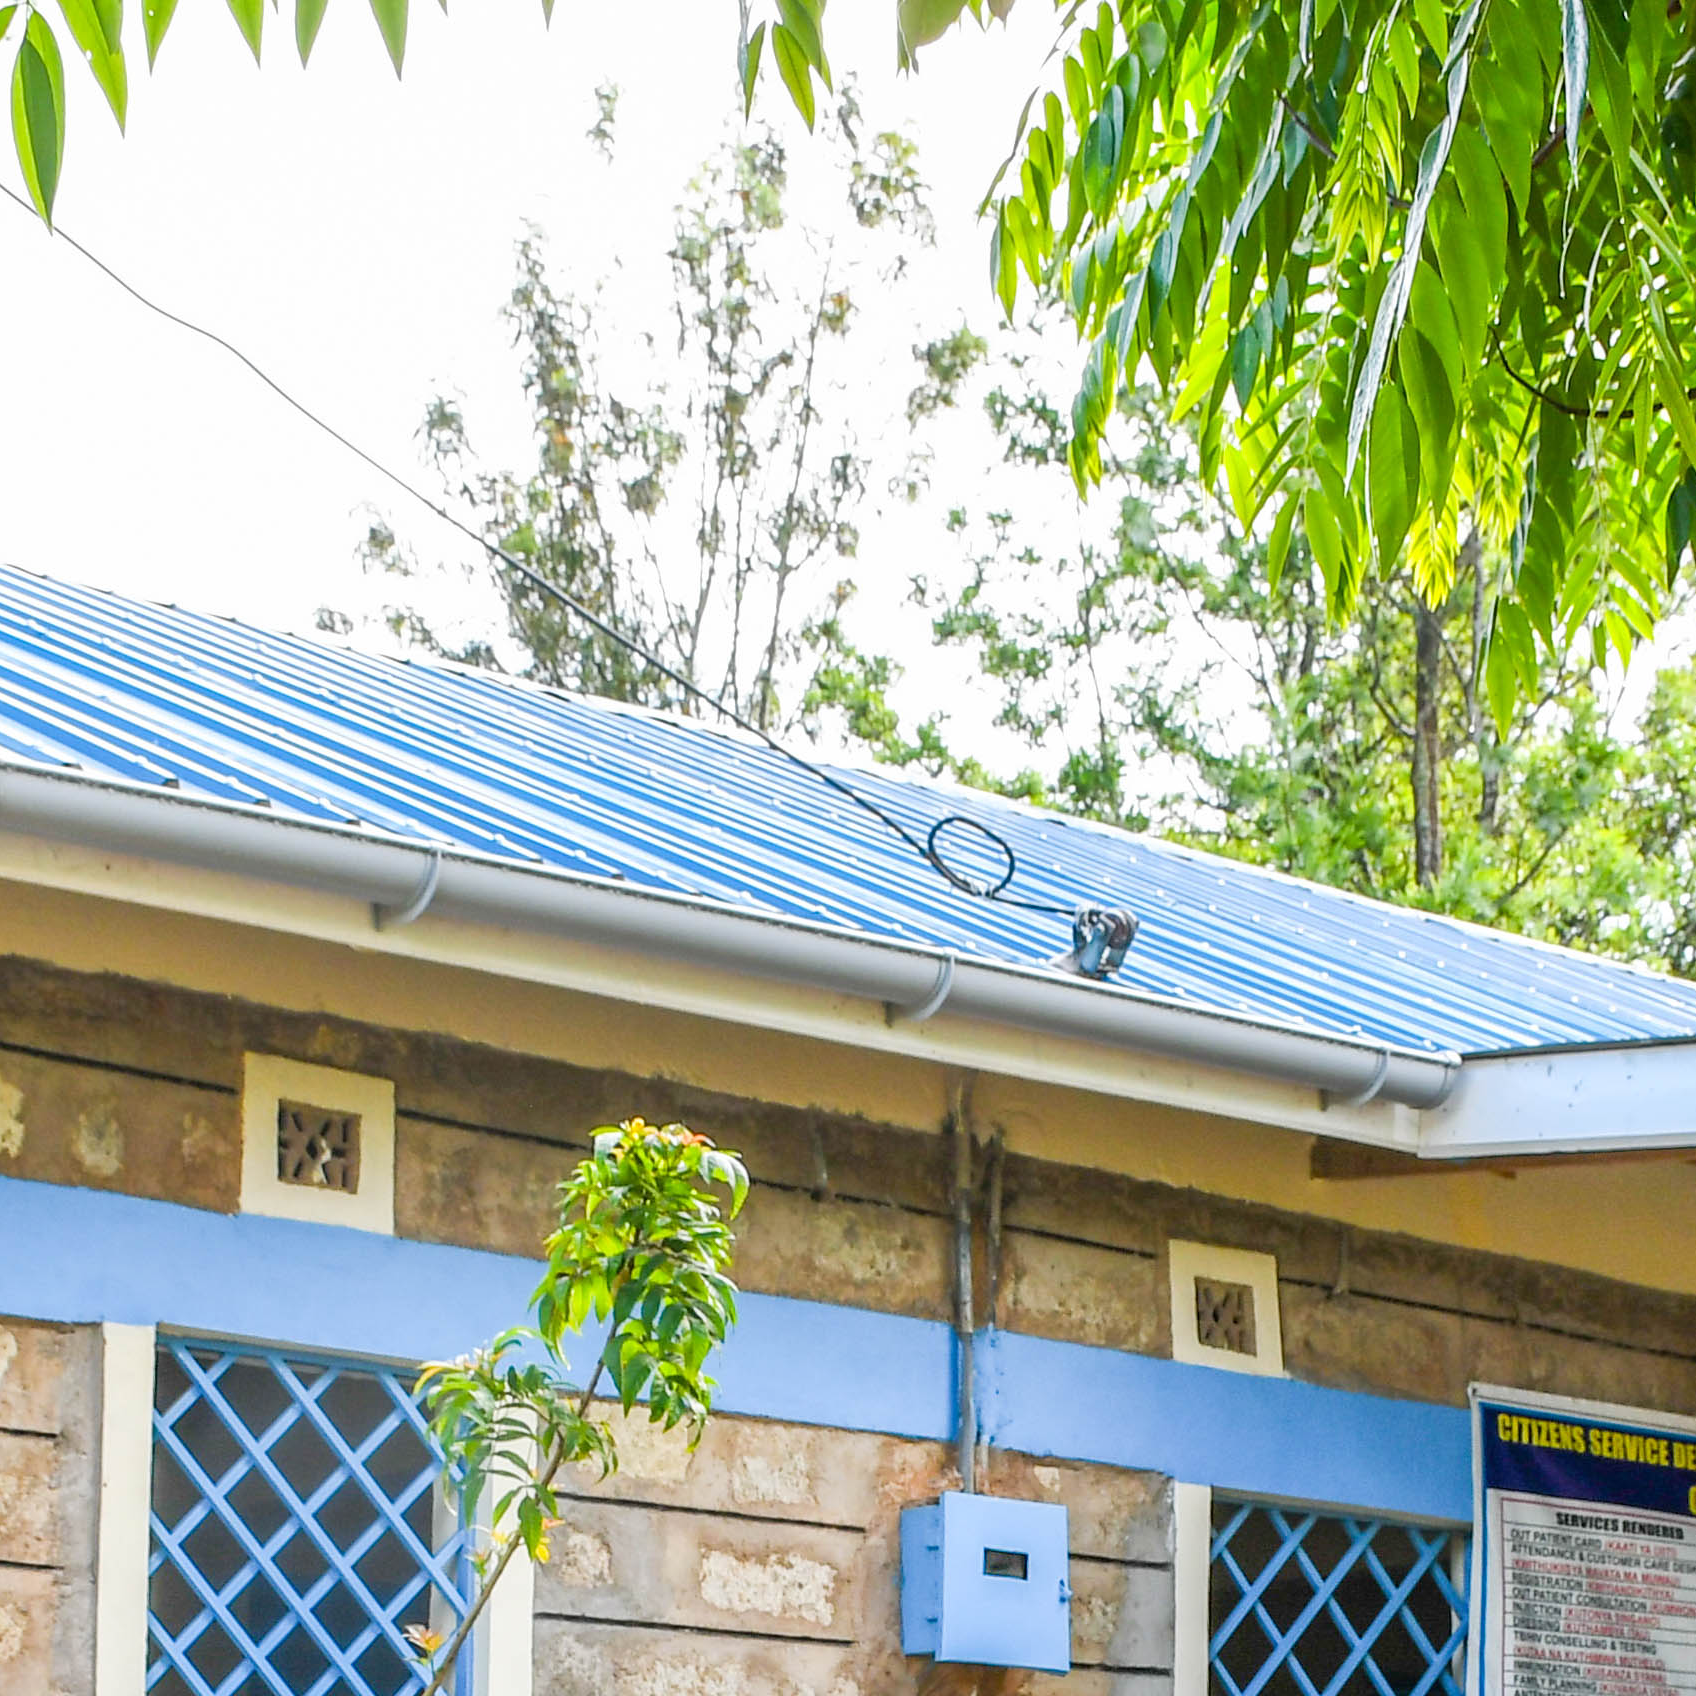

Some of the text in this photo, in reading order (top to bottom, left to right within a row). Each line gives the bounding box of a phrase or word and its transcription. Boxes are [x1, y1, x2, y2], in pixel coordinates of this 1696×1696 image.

[1497, 1413, 1586, 1453] CITIZENS
[1589, 1428, 1670, 1467] SERVICE
[1556, 1512, 1684, 1540] SERVICES RENDERED
[1510, 1528, 1530, 1540] OUT
[1534, 1531, 1572, 1545] PATIENT
[1575, 1536, 1602, 1548] CARD
[1511, 1544, 1575, 1560] ATTENDANCE
[1587, 1553, 1640, 1568] CUSTOMER
[1644, 1559, 1670, 1571] CARE
[1512, 1572, 1583, 1589] REGISTRATION
[1512, 1587, 1530, 1599] OUT
[1534, 1590, 1573, 1604] PATIENT
[1577, 1594, 1647, 1611] CONSULTATION
[1620, 1642, 1656, 1655] TESTING
[1514, 1660, 1581, 1676] IMMUNIZATION
[1514, 1675, 1545, 1688] FAMILY
[1548, 1678, 1597, 1692] PLANNING
